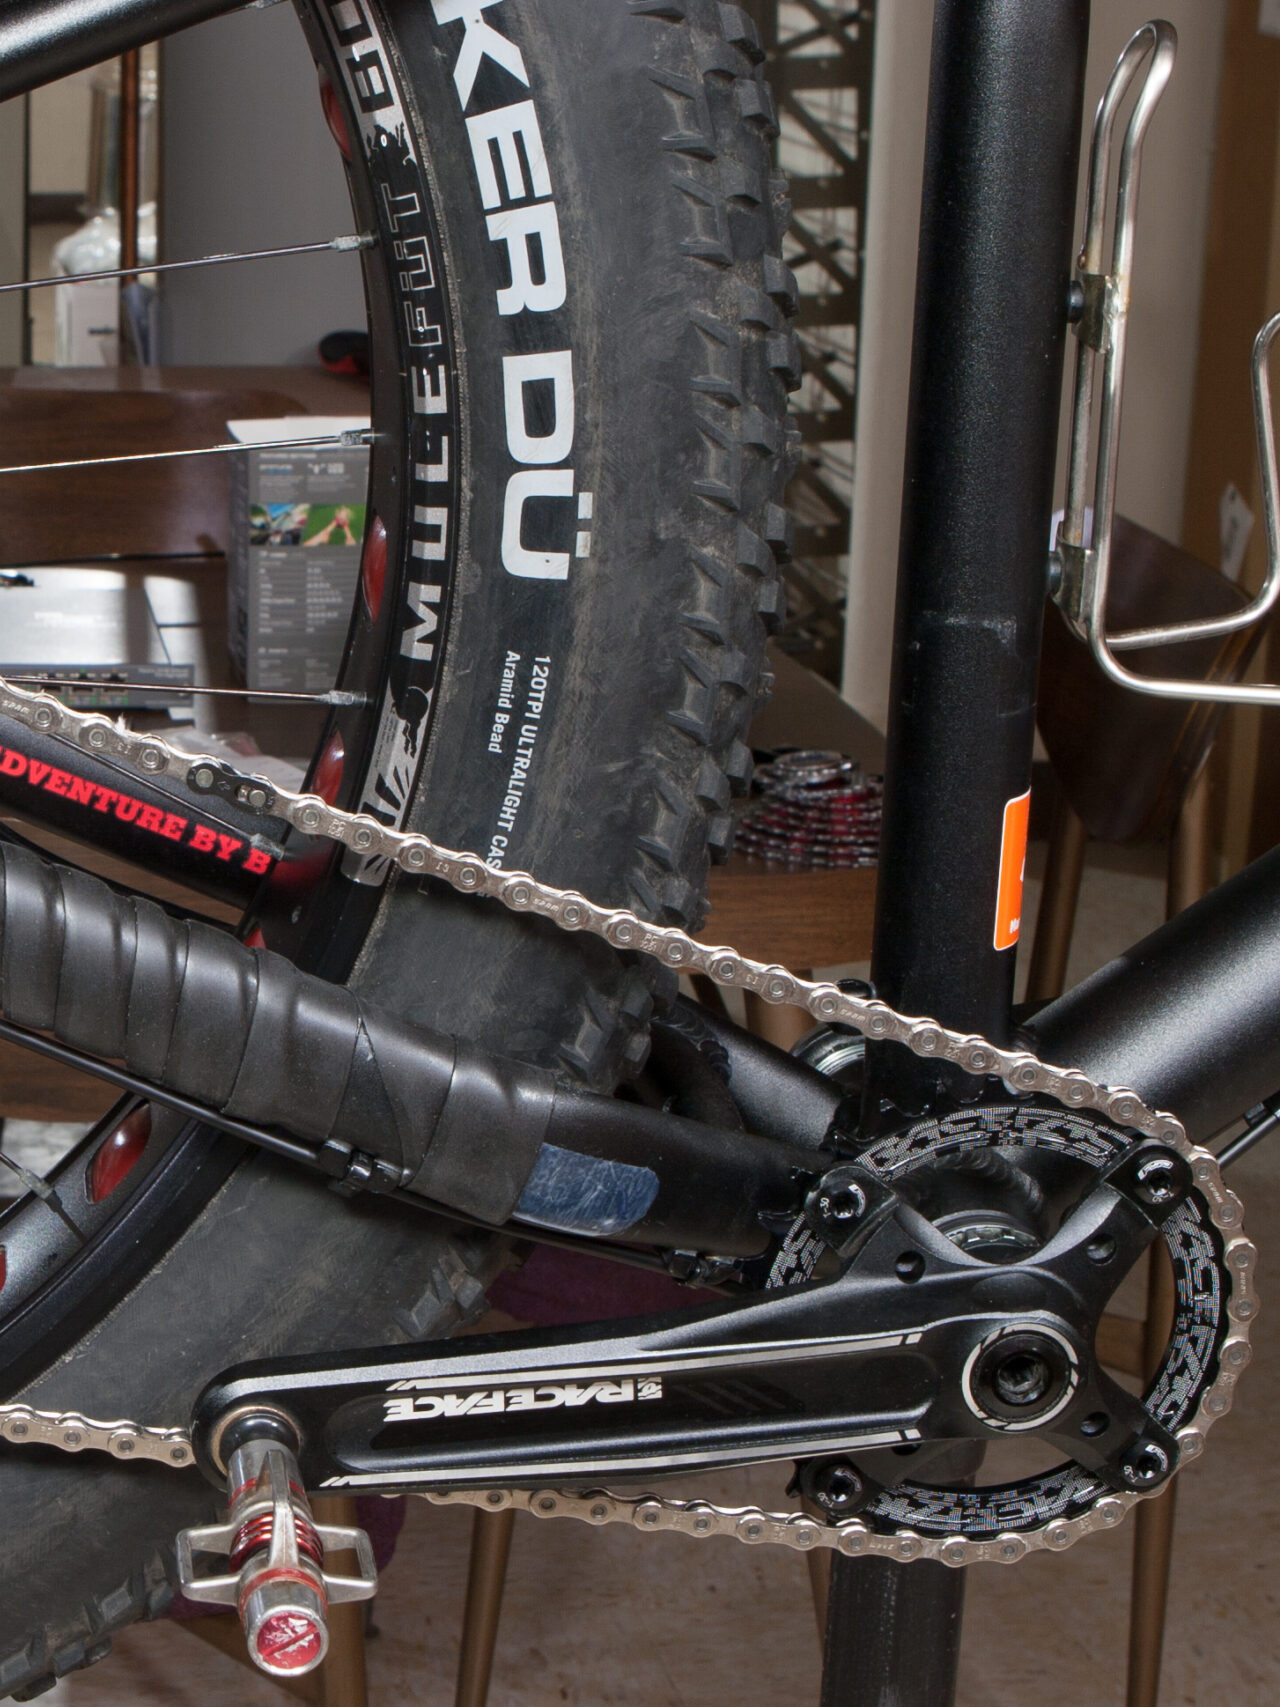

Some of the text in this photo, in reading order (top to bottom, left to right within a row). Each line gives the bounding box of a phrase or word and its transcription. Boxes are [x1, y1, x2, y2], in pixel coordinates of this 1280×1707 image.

[432, 0, 593, 580] KER DÜ
[488, 650, 521, 754] Aramid Bead
[524, 655, 551, 719] 120TPI
[497, 724, 538, 832] ULTRALIGHT
[188, 823, 243, 862] BY
